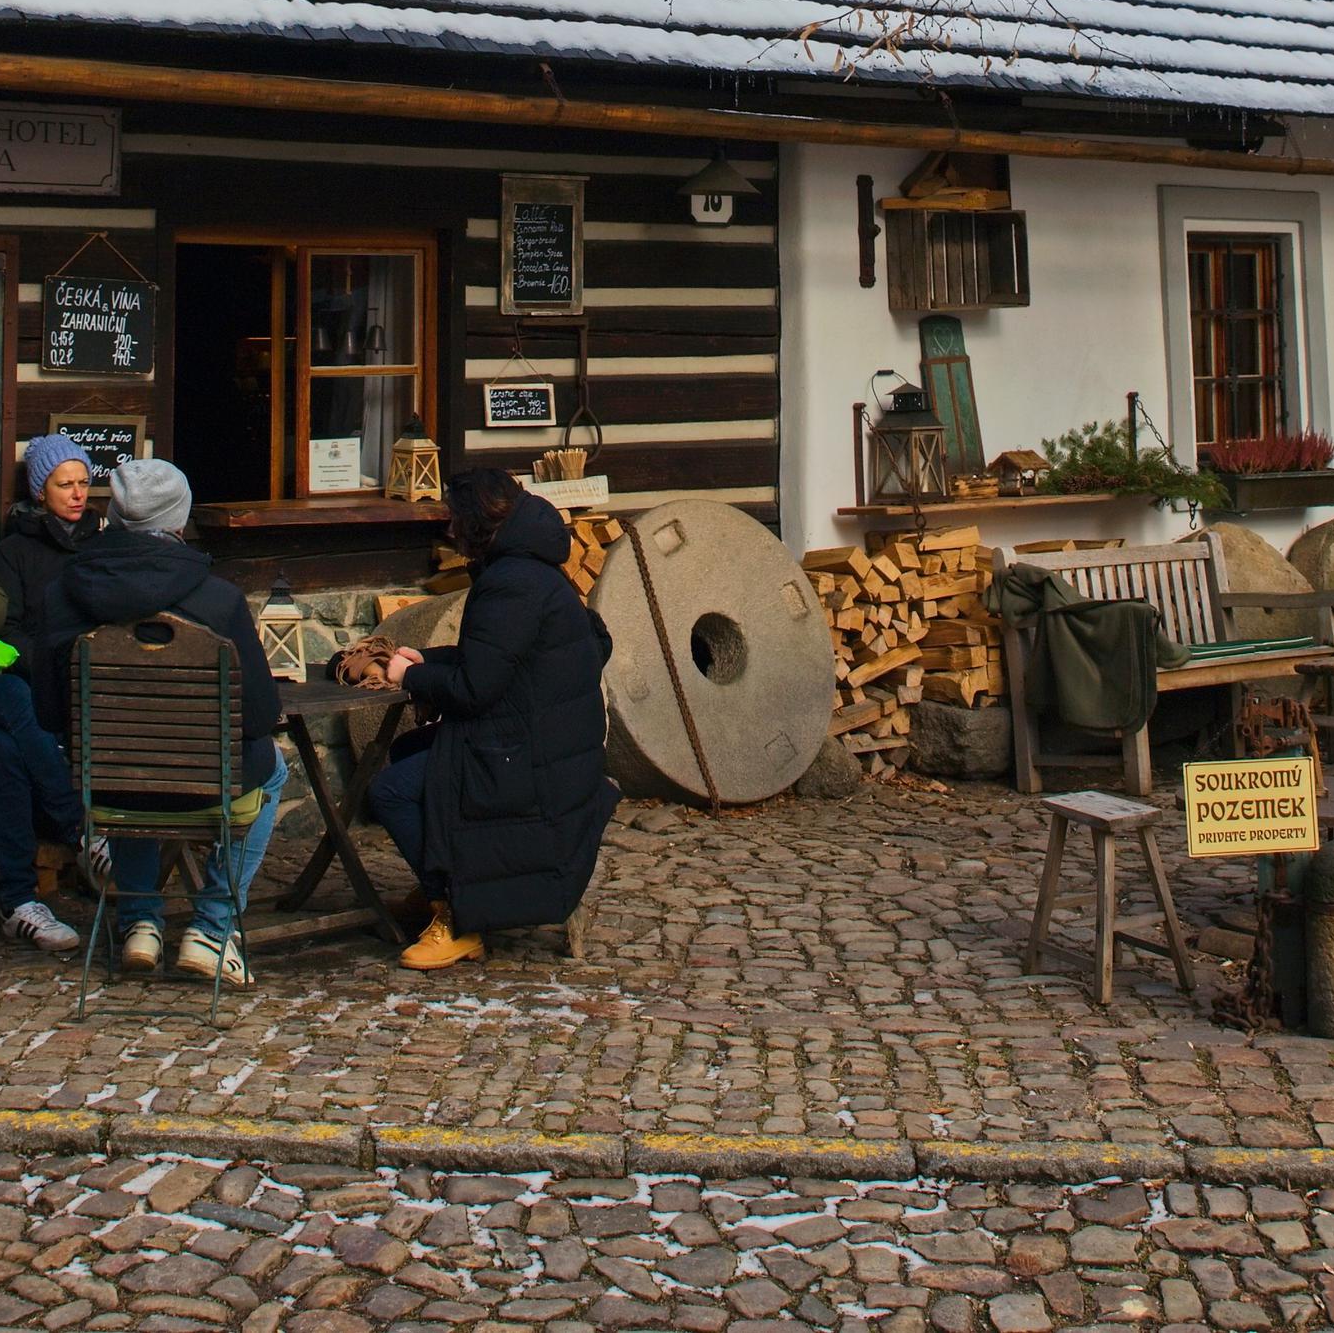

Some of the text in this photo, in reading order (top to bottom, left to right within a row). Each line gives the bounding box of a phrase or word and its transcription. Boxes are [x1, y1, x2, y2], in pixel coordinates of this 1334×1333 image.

[55, 282, 102, 308] ČESKÁ
[111, 287, 141, 310] VÍNA
[60, 311, 128, 333] ZAHRANIČNÍ
[1195, 765, 1302, 792] SOUKROMÝ
[1197, 797, 1306, 822] POZEMEK
[1199, 827, 1306, 844] PRIVATE PROPERTY
